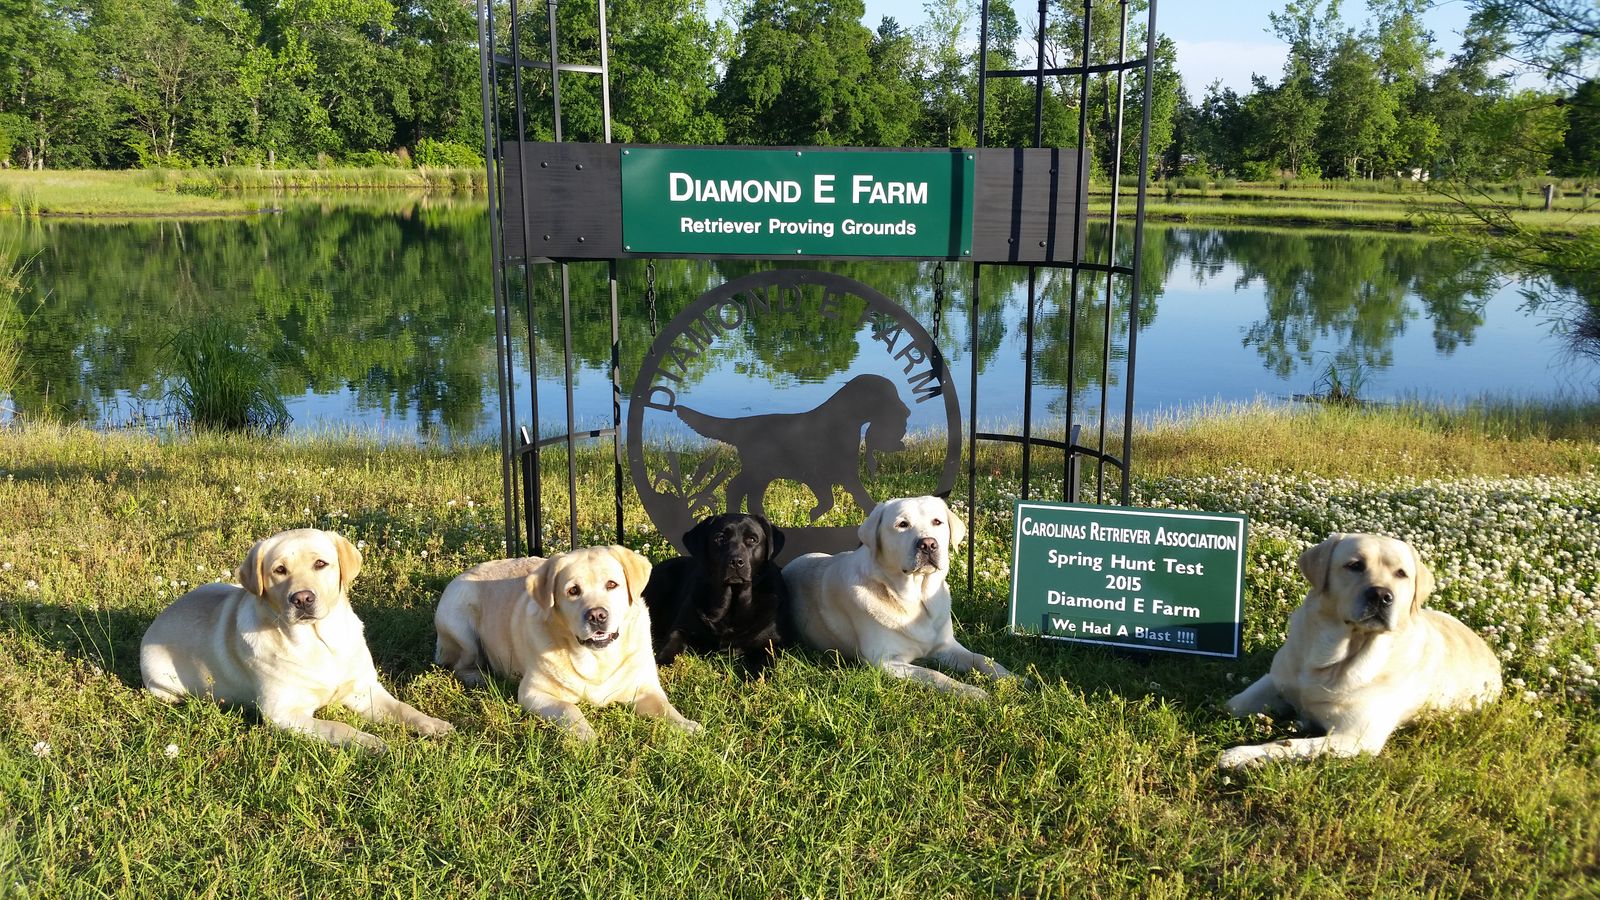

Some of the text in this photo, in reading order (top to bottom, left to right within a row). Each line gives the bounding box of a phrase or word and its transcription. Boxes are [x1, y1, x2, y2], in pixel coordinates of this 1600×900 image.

[669, 172, 928, 205] DIAMOND E FARM
[680, 217, 917, 237] Retriever Proving Grounds
[645, 282, 943, 412] DIAMOND E FARM
[1021, 517, 1237, 551] CAROLINAS RETRIEVER ASSOCIATION
[1048, 549, 1204, 576] Spring Hunt Test
[1106, 575, 1142, 592] 2015
[1047, 590, 1201, 618] Diamond E Farm
[1052, 617, 1077, 632] We
[1082, 621, 1111, 636] Had
[1117, 625, 1129, 637] A
[1135, 627, 1171, 643] Blast
